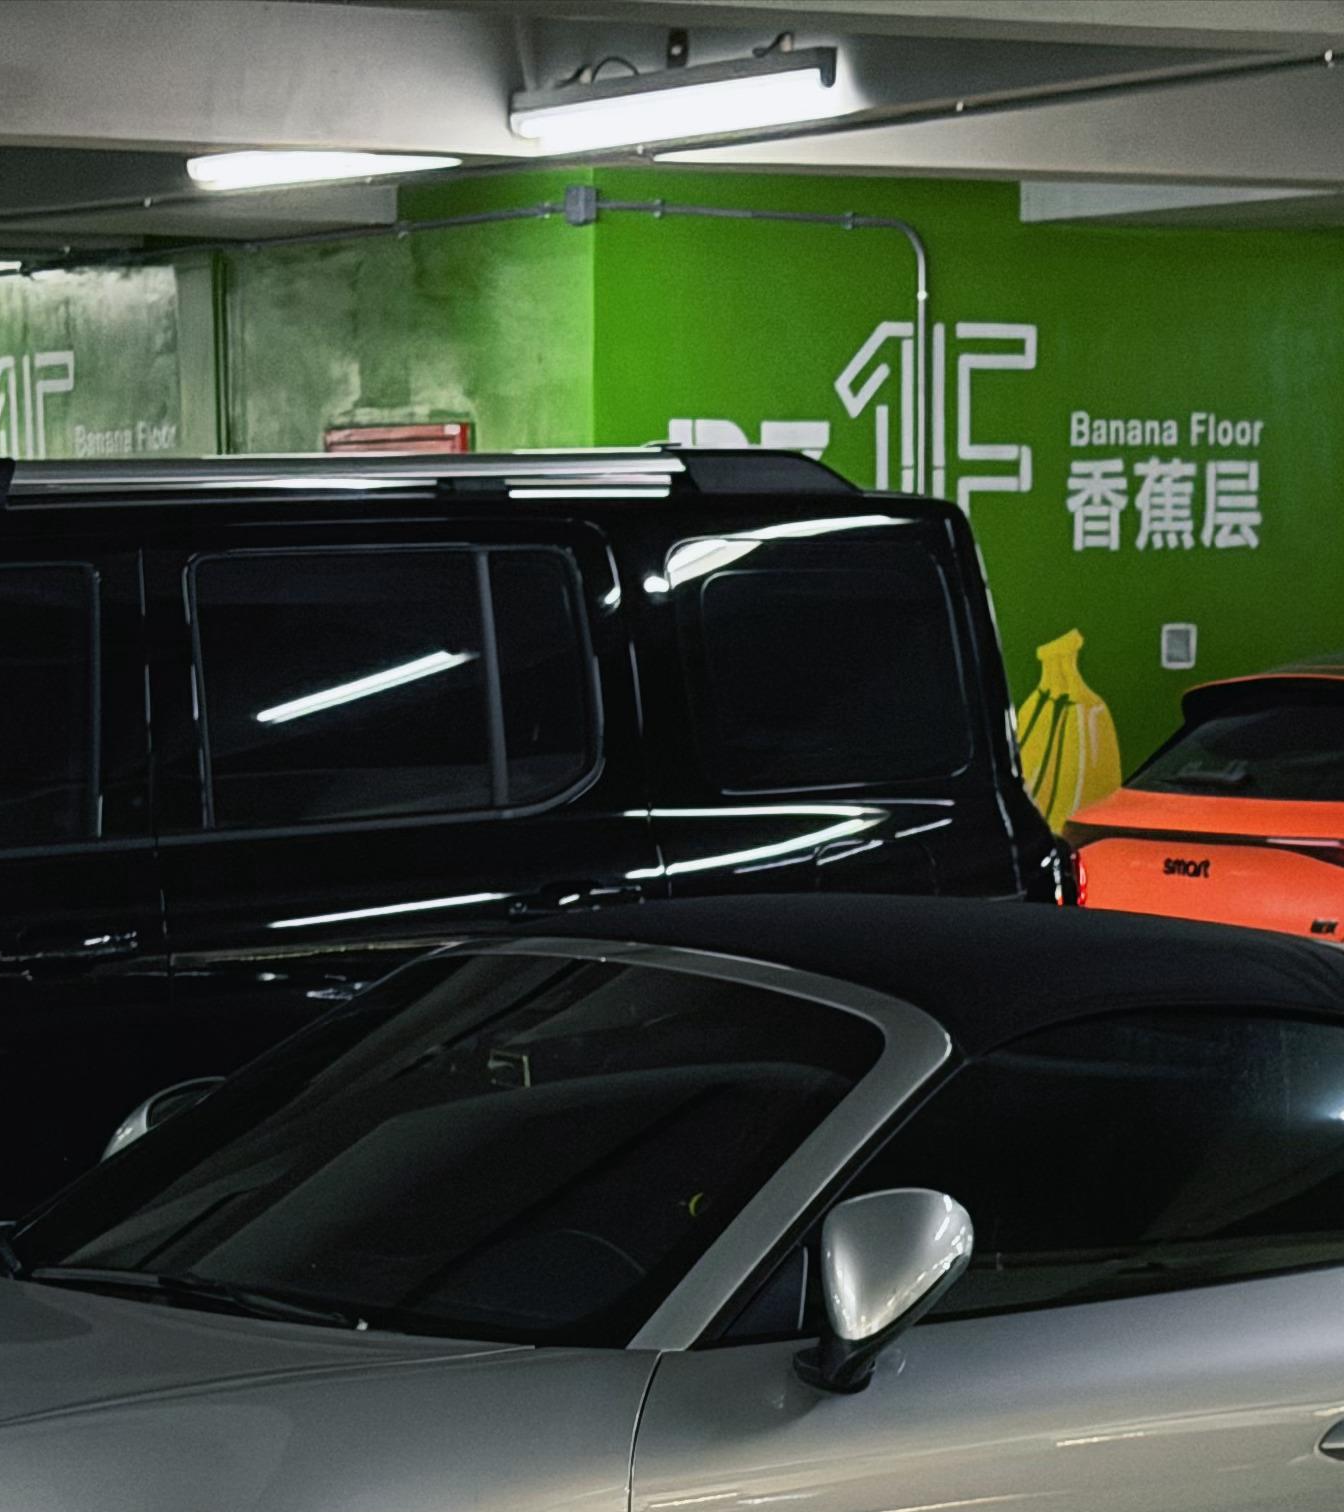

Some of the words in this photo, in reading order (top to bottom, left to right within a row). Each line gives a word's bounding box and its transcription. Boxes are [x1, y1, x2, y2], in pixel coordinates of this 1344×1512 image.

[1070, 410, 1178, 446] Banana
[1190, 412, 1263, 446] Floor
[1066, 456, 1262, 551] 香蕉层
[1163, 857, 1210, 878] smart
